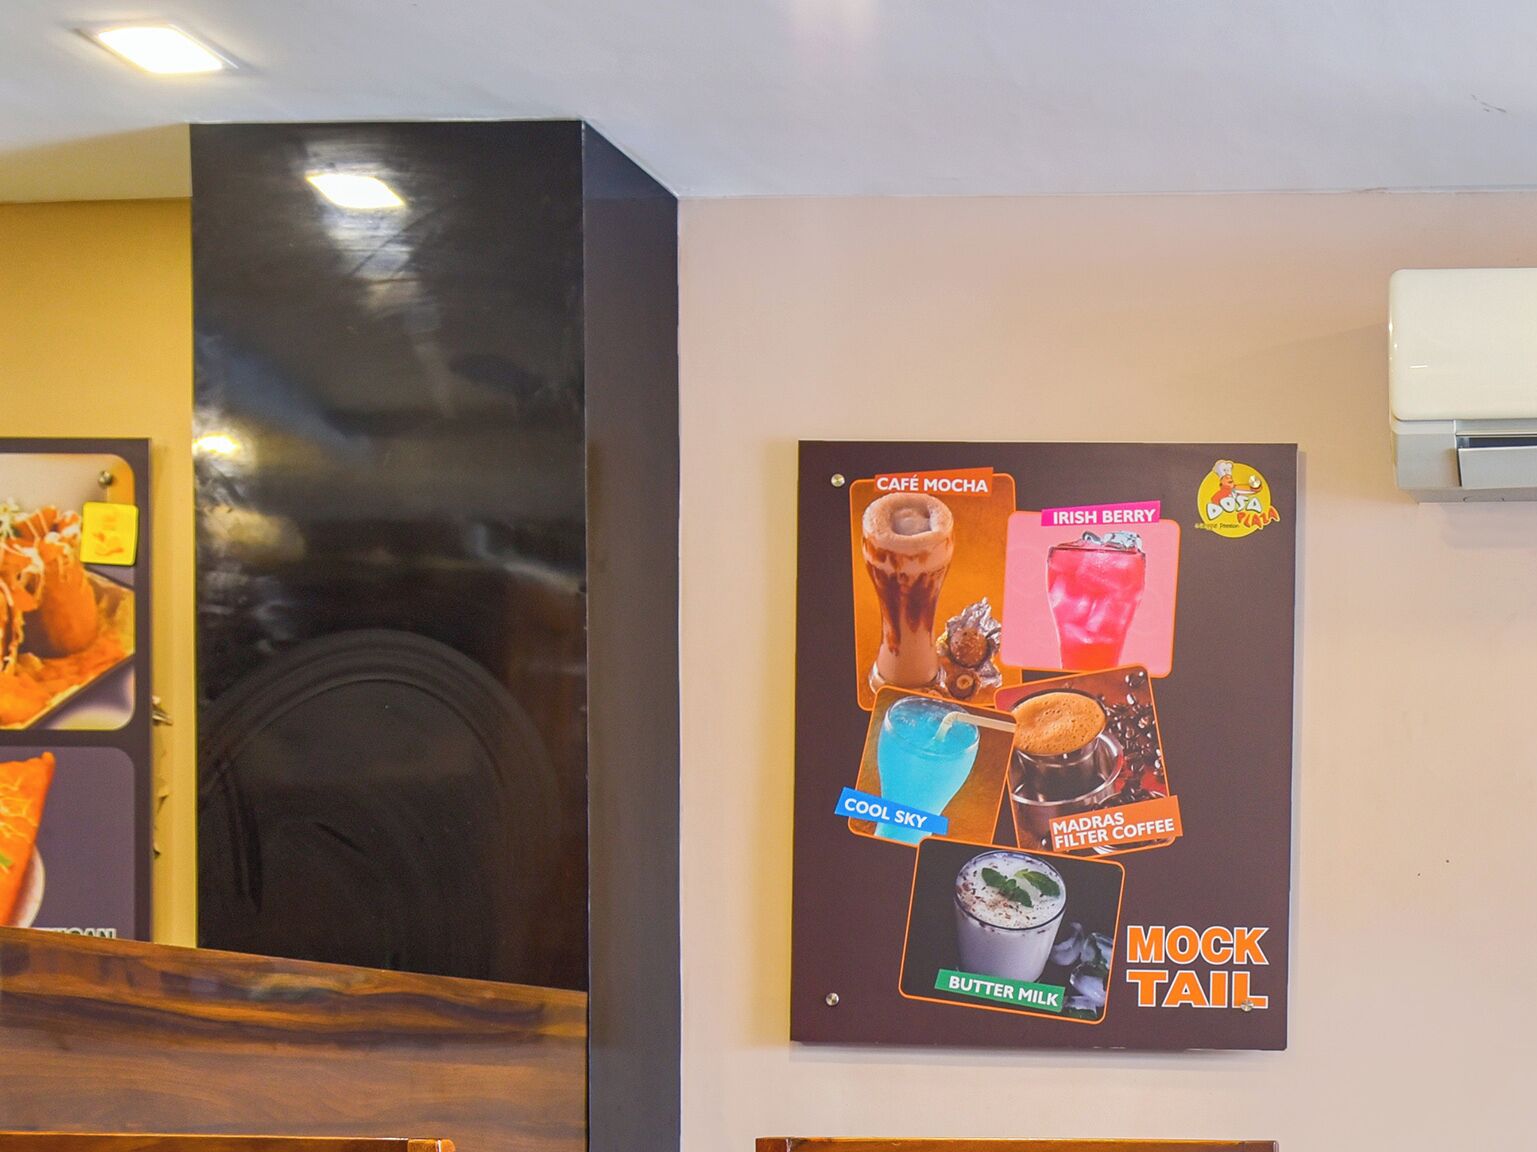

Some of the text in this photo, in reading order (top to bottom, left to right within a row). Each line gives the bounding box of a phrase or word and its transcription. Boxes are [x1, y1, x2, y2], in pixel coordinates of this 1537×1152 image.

[876, 474, 988, 493] CAFÉ MOCHA
[1053, 508, 1156, 525] IRISH BERRY
[1206, 495, 1262, 521] DOSA
[1236, 505, 1280, 530] PLAZA
[844, 797, 928, 828] COOL SKY
[1052, 811, 1125, 835] MADRAS
[1054, 818, 1175, 849] FILTER COFFEE
[1126, 925, 1270, 966] MOCK
[948, 975, 1059, 1007] BUTTER MILK
[1125, 969, 1270, 1010] TAIL
